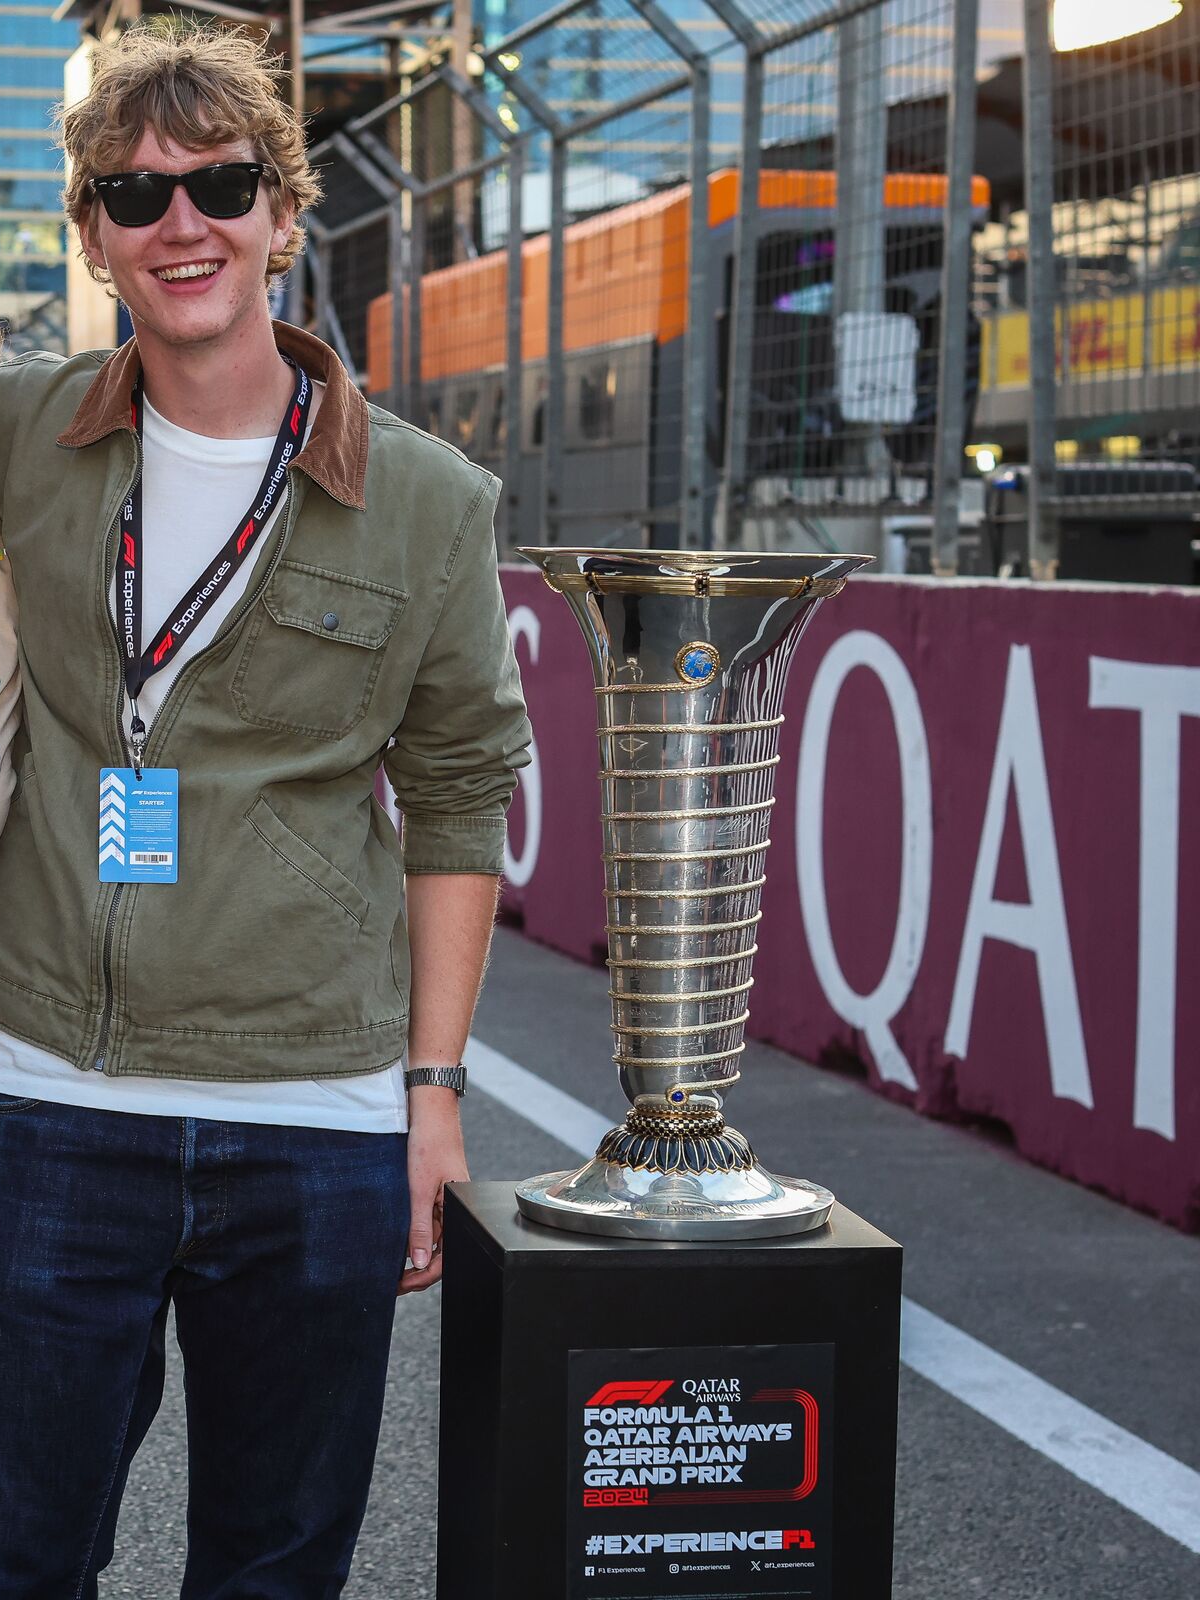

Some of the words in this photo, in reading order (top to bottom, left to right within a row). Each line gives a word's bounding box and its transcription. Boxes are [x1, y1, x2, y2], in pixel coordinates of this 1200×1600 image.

[254, 442, 294, 522] Experiences
[171, 560, 232, 636] Experiences
[123, 570, 135, 659] Experiences
[682, 1379, 740, 1397] QATAR
[695, 1393, 741, 1403] AIRWAYS
[584, 1405, 714, 1426] FORMULA
[718, 1405, 733, 1422] 1
[584, 1426, 671, 1447] QATAR
[675, 1423, 792, 1444] AIRWAYS
[584, 1444, 747, 1467] AZERBAIJAN
[584, 1467, 677, 1487] GRAND
[681, 1464, 743, 1484] PRIX
[585, 1489, 648, 1506] 2024
[585, 1529, 815, 1555] #EXPERIENCEF1
[607, 1566, 646, 1574] Experiences
[682, 1563, 731, 1571] @f1experiences
